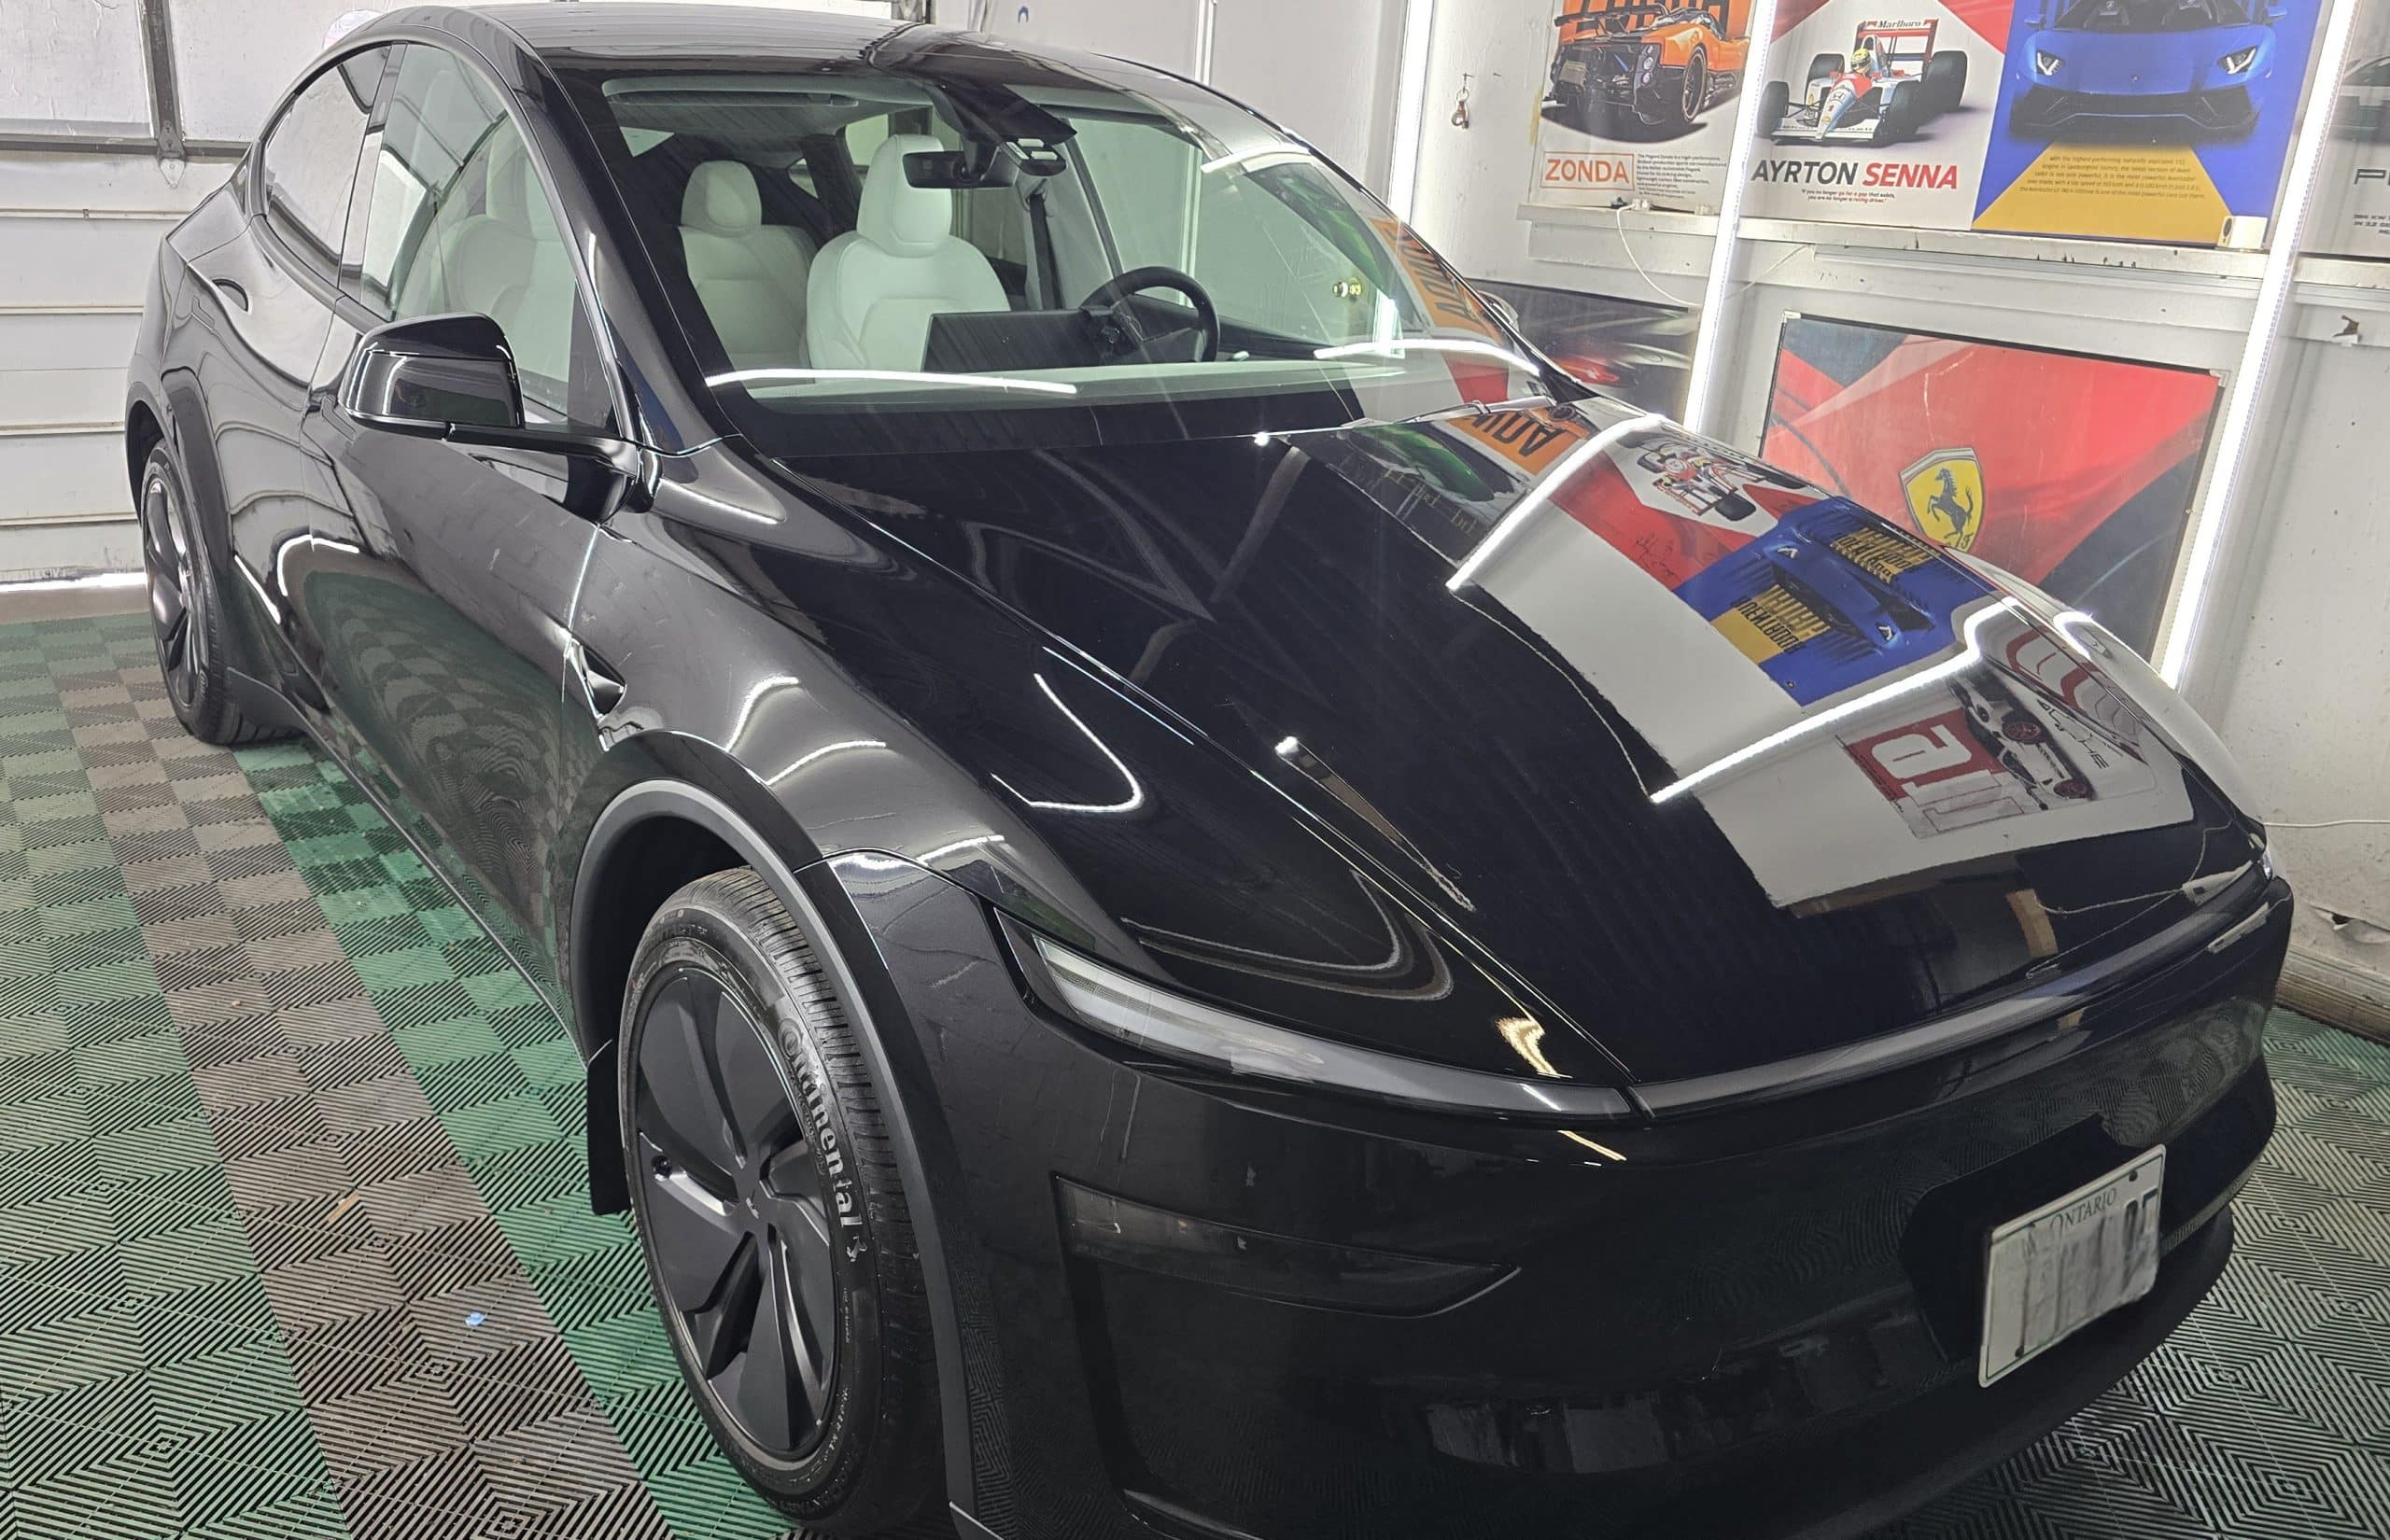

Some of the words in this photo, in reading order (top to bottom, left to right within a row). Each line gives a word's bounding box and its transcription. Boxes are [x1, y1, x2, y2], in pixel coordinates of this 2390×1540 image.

[1877, 20, 1921, 29] Marlboro
[1545, 159, 1629, 184] ZONDA
[1751, 160, 1858, 185] AYRTON
[1863, 162, 1957, 189] SENNA
[777, 1017, 864, 1228] Continental
[2050, 1187, 2117, 1233] ONTARIO
